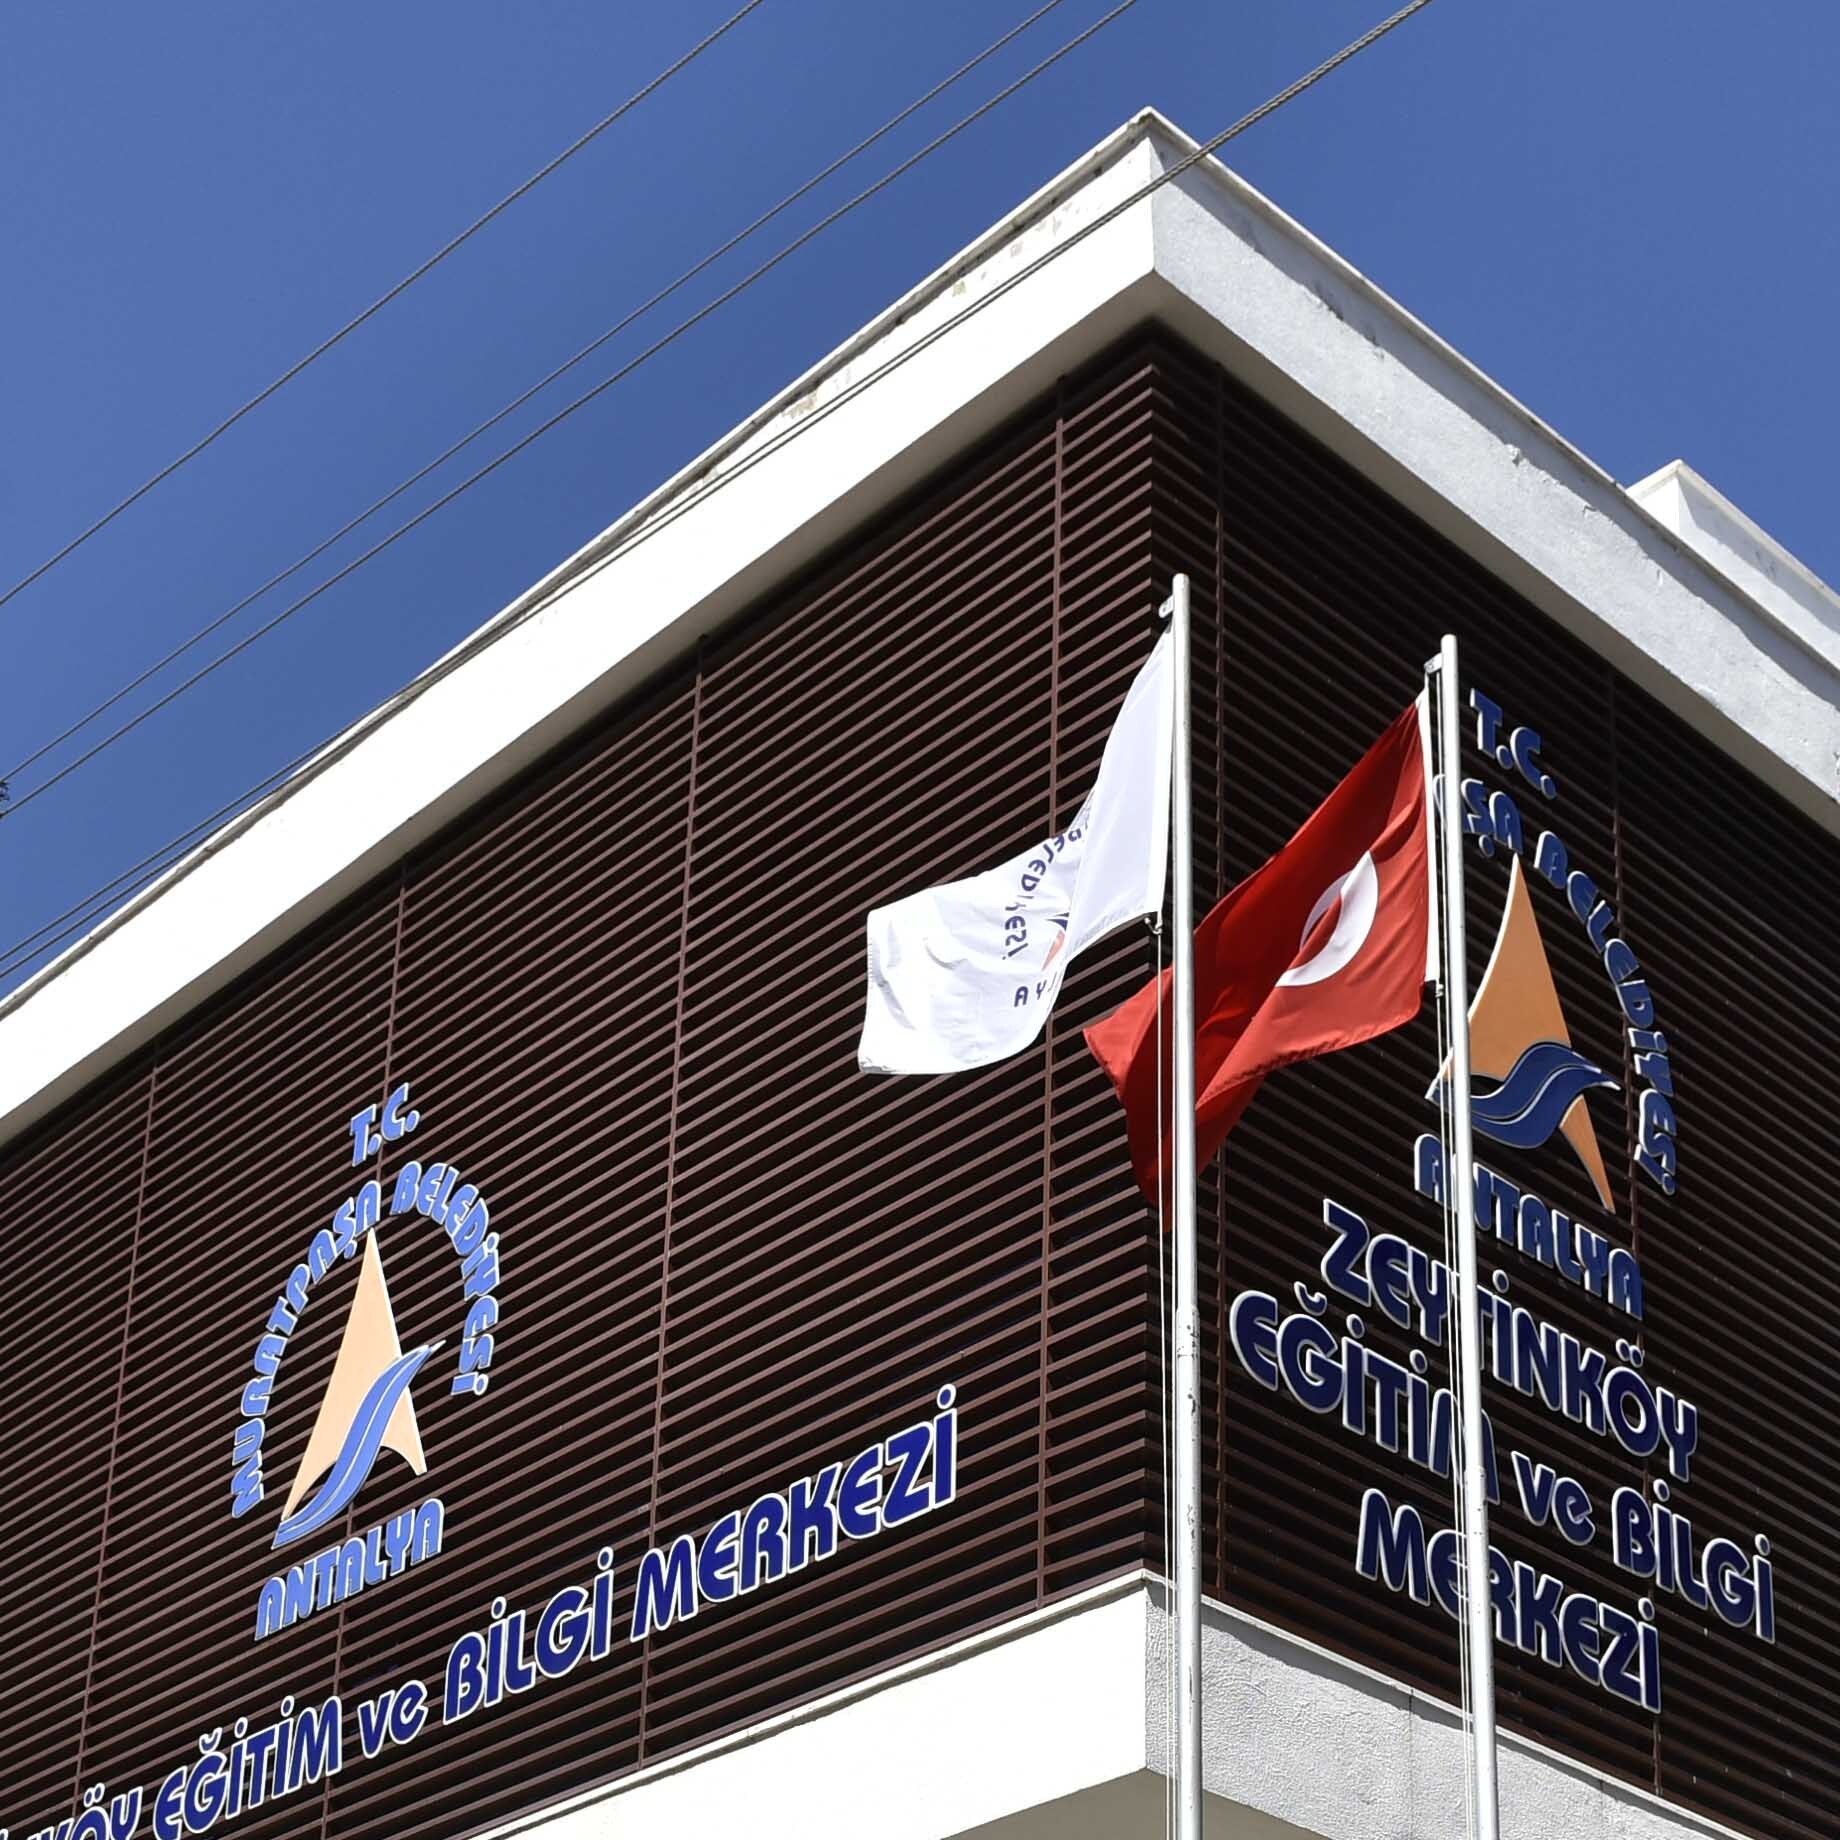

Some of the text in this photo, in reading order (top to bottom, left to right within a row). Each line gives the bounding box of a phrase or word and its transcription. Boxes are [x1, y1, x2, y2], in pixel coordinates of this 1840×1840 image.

[1469, 687, 1557, 800] T.C.
[1533, 830, 1677, 1197] BELEDİYESİ
[349, 1082, 420, 1167] T.C.
[230, 1160, 502, 1520] MURATPAŞA BELEDİYESİ
[254, 1497, 446, 1642] ANTALYA
[357, 1680, 428, 1760] ve
[443, 1546, 615, 1727] BİLGİ
[629, 1382, 959, 1644] MERKEZİ
[1356, 1488, 1662, 1715] MERKEZİ
[1511, 1451, 1596, 1546] ve
[1612, 1478, 1778, 1645] BİLGİ
